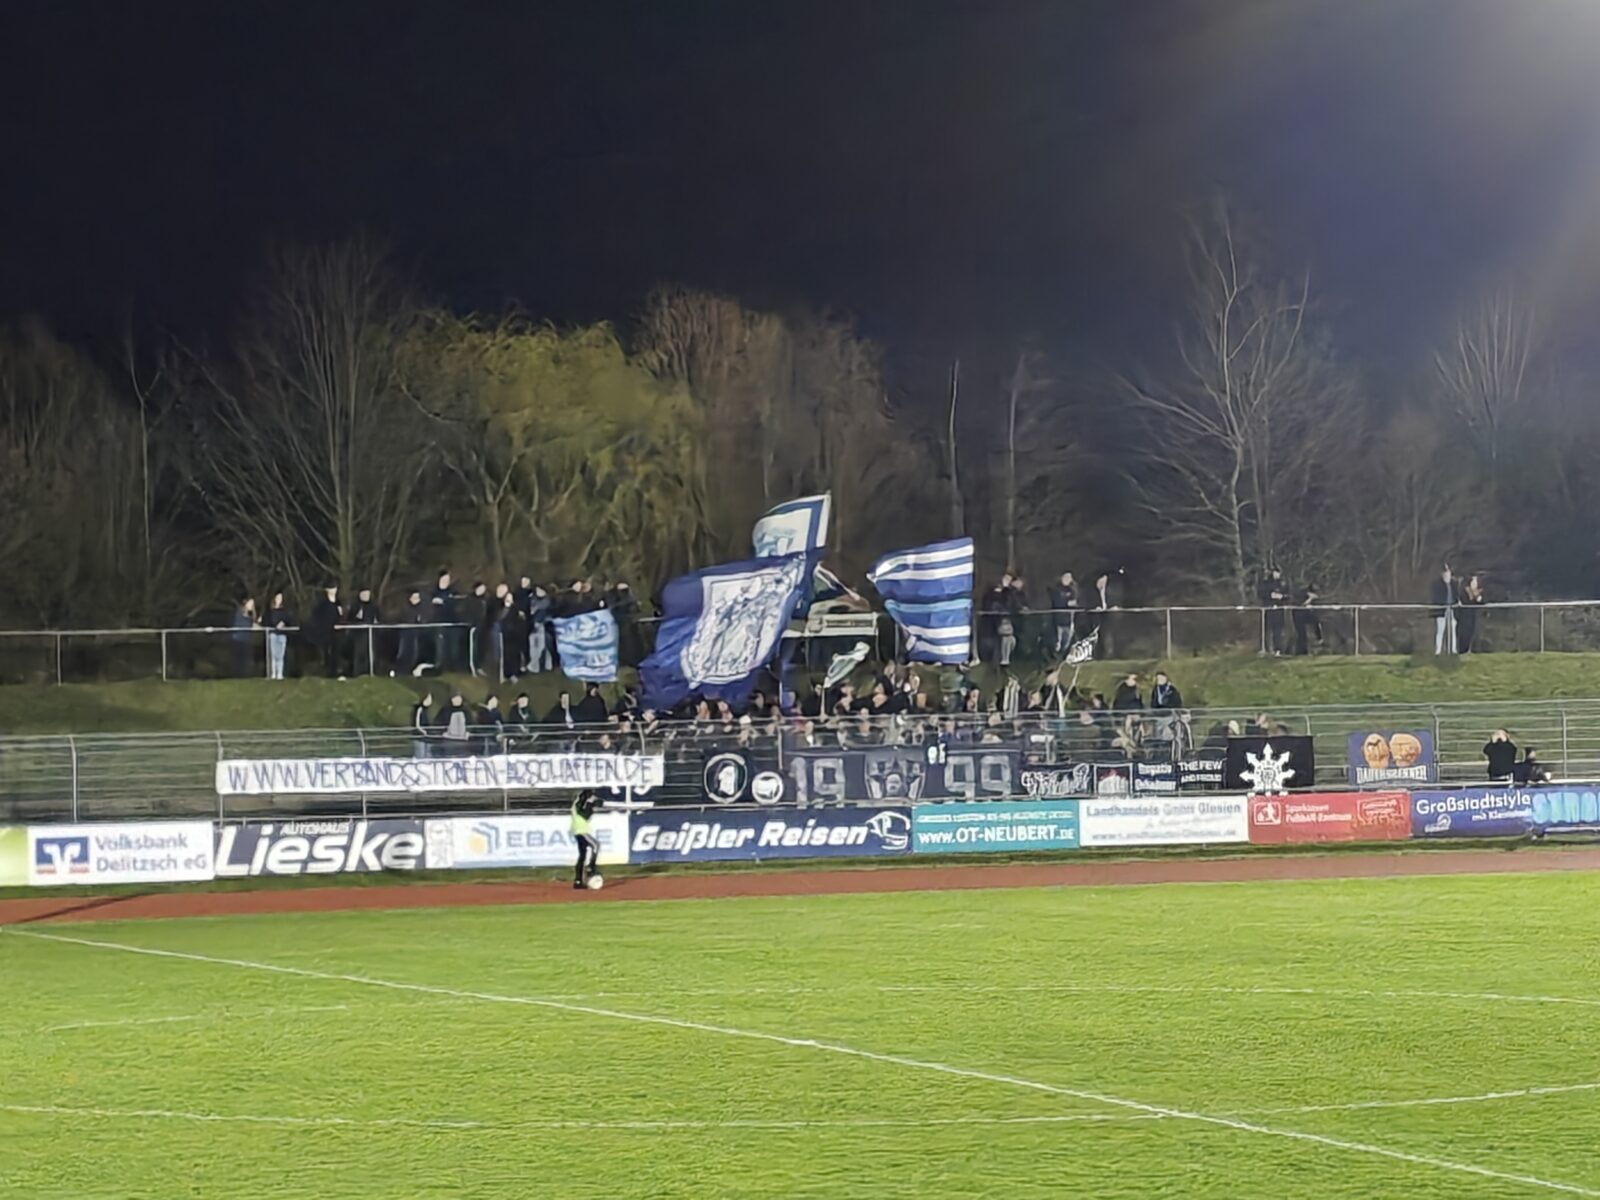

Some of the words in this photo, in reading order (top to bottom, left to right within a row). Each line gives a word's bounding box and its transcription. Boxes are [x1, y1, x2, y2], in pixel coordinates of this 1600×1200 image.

[1178, 760, 1199, 772] THE
[1200, 759, 1223, 771] FEW
[789, 756, 846, 808] 19
[944, 755, 1013, 802] 99
[280, 821, 349, 836] AUTOHAUS
[632, 822, 754, 855] Geißler
[759, 818, 867, 847] Reisen
[95, 832, 188, 851] Volksbank
[215, 821, 424, 875] Lieske
[96, 854, 178, 872] Delitzsch
[183, 854, 207, 870] eG
